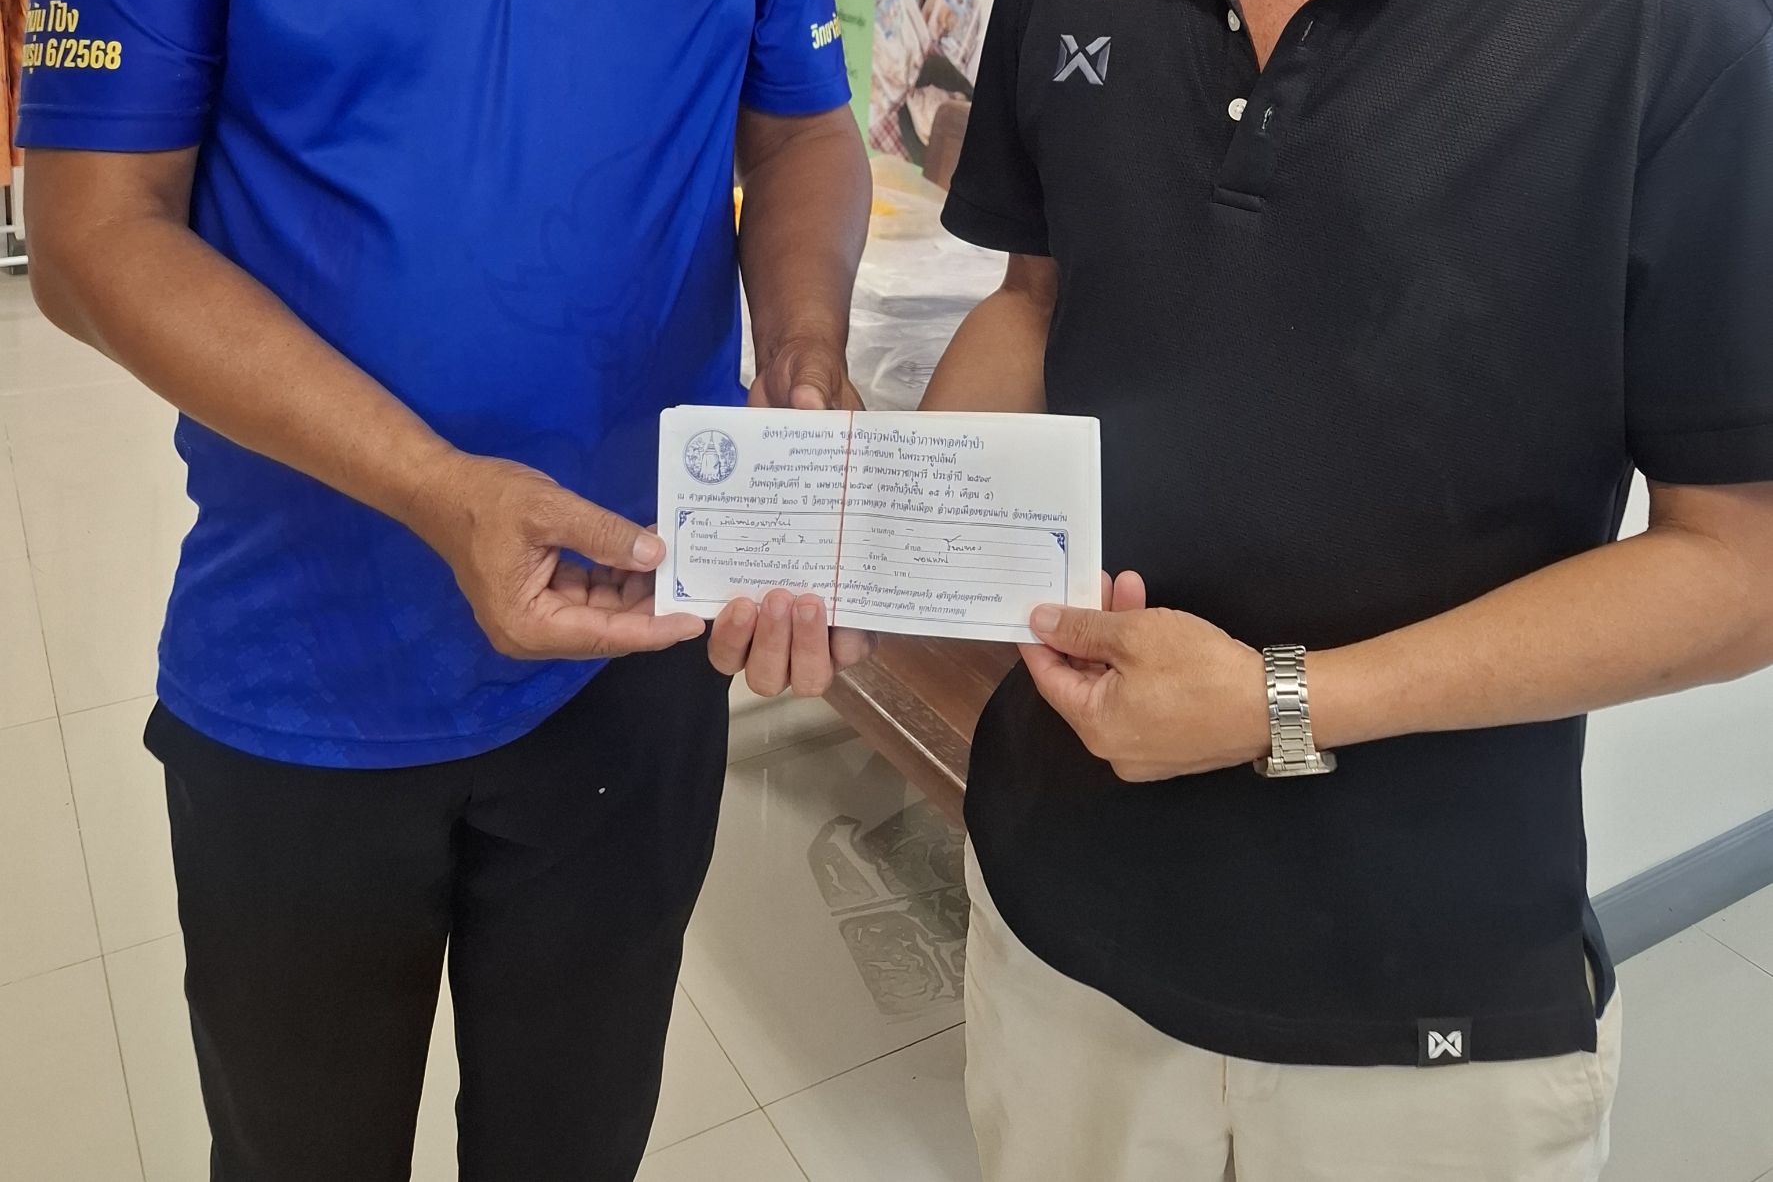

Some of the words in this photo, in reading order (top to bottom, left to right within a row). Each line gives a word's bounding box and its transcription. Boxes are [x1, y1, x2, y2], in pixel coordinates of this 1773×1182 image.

[45, 38, 122, 70] 6/2568
[762, 426, 834, 440] จังหวัดขอนแก่น
